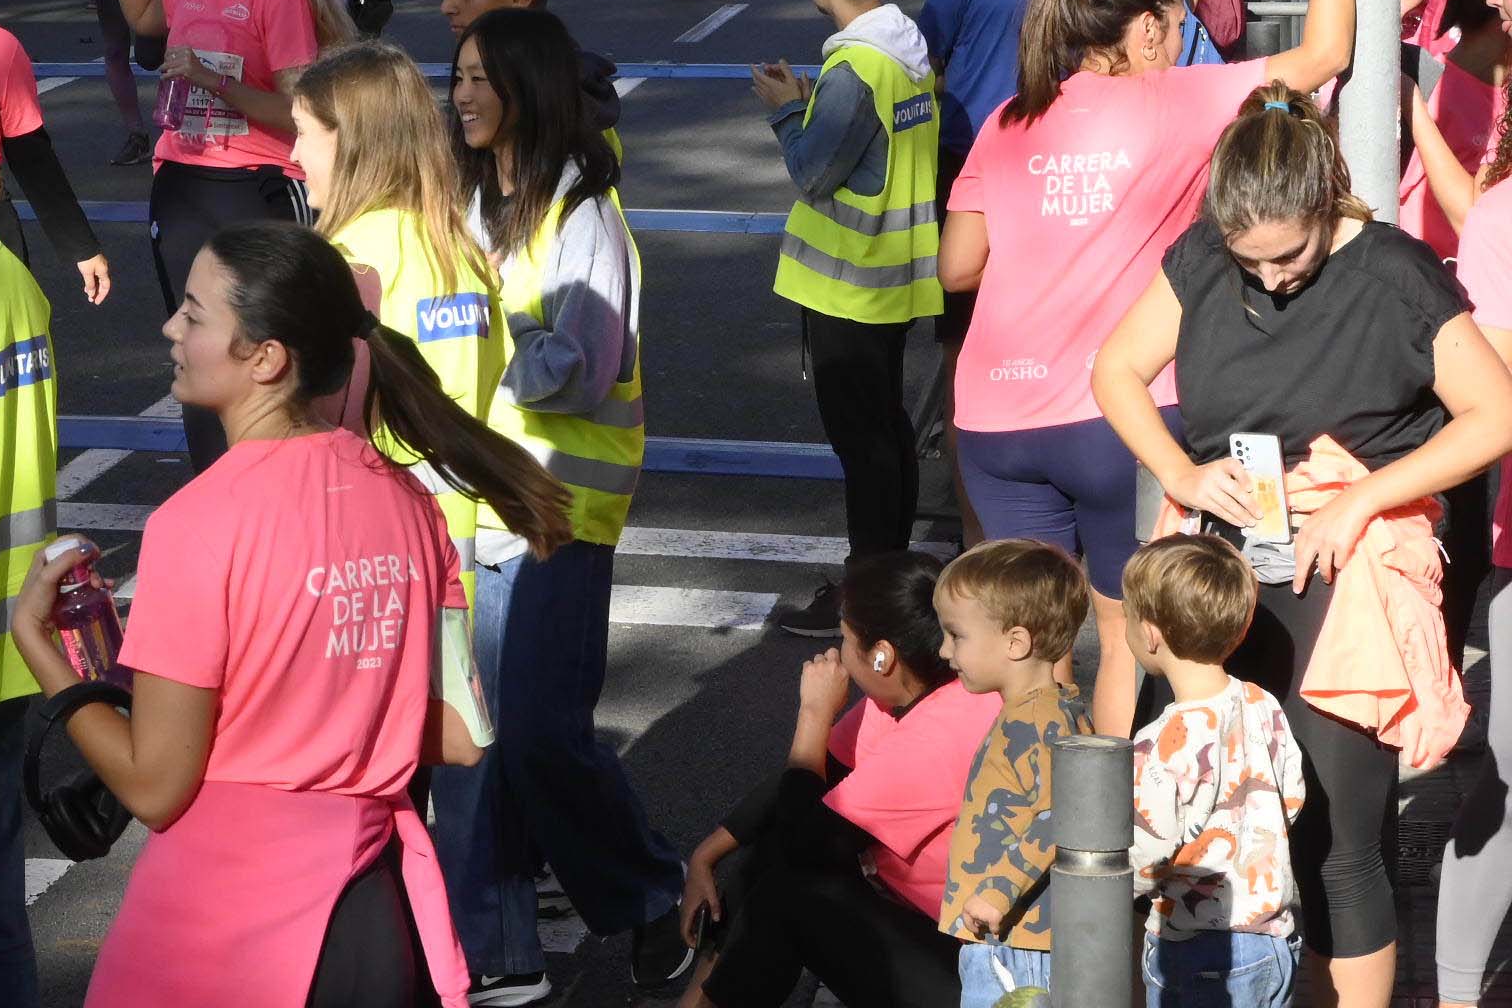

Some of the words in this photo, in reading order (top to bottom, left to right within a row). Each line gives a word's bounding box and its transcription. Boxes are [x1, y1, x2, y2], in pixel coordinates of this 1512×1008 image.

[1028, 148, 1132, 175] CARRERA
[1046, 174, 1075, 195] DE
[1083, 173, 1111, 193] LA
[1041, 192, 1114, 217] MUJER
[990, 364, 1049, 381] OYSHO
[306, 553, 420, 597] CARRERA
[333, 596, 368, 626] DE
[372, 590, 405, 620] LA
[356, 657, 382, 670] 2023
